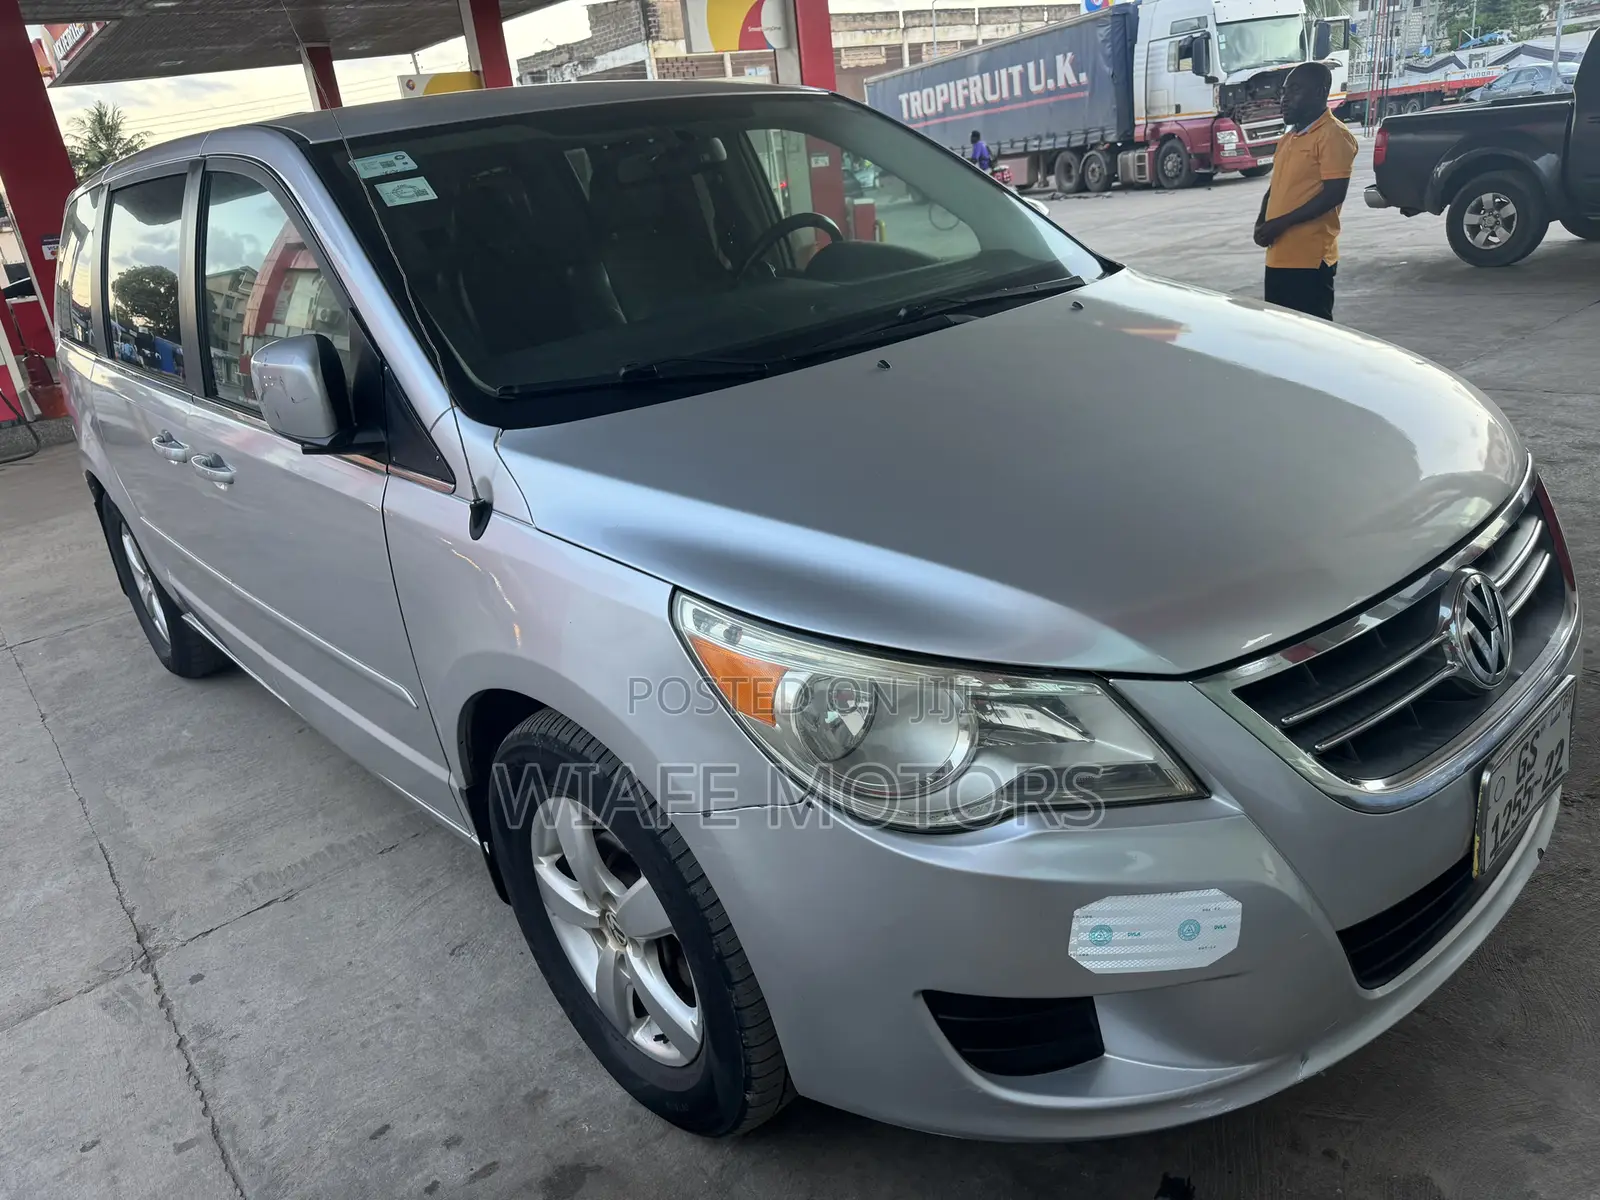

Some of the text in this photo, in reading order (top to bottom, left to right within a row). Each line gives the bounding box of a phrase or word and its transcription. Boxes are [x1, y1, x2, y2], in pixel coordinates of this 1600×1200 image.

[898, 52, 1089, 120] TROPIFRUIT U.K.
[1516, 728, 1540, 785] GS
[1489, 738, 1565, 860] 1255-22
